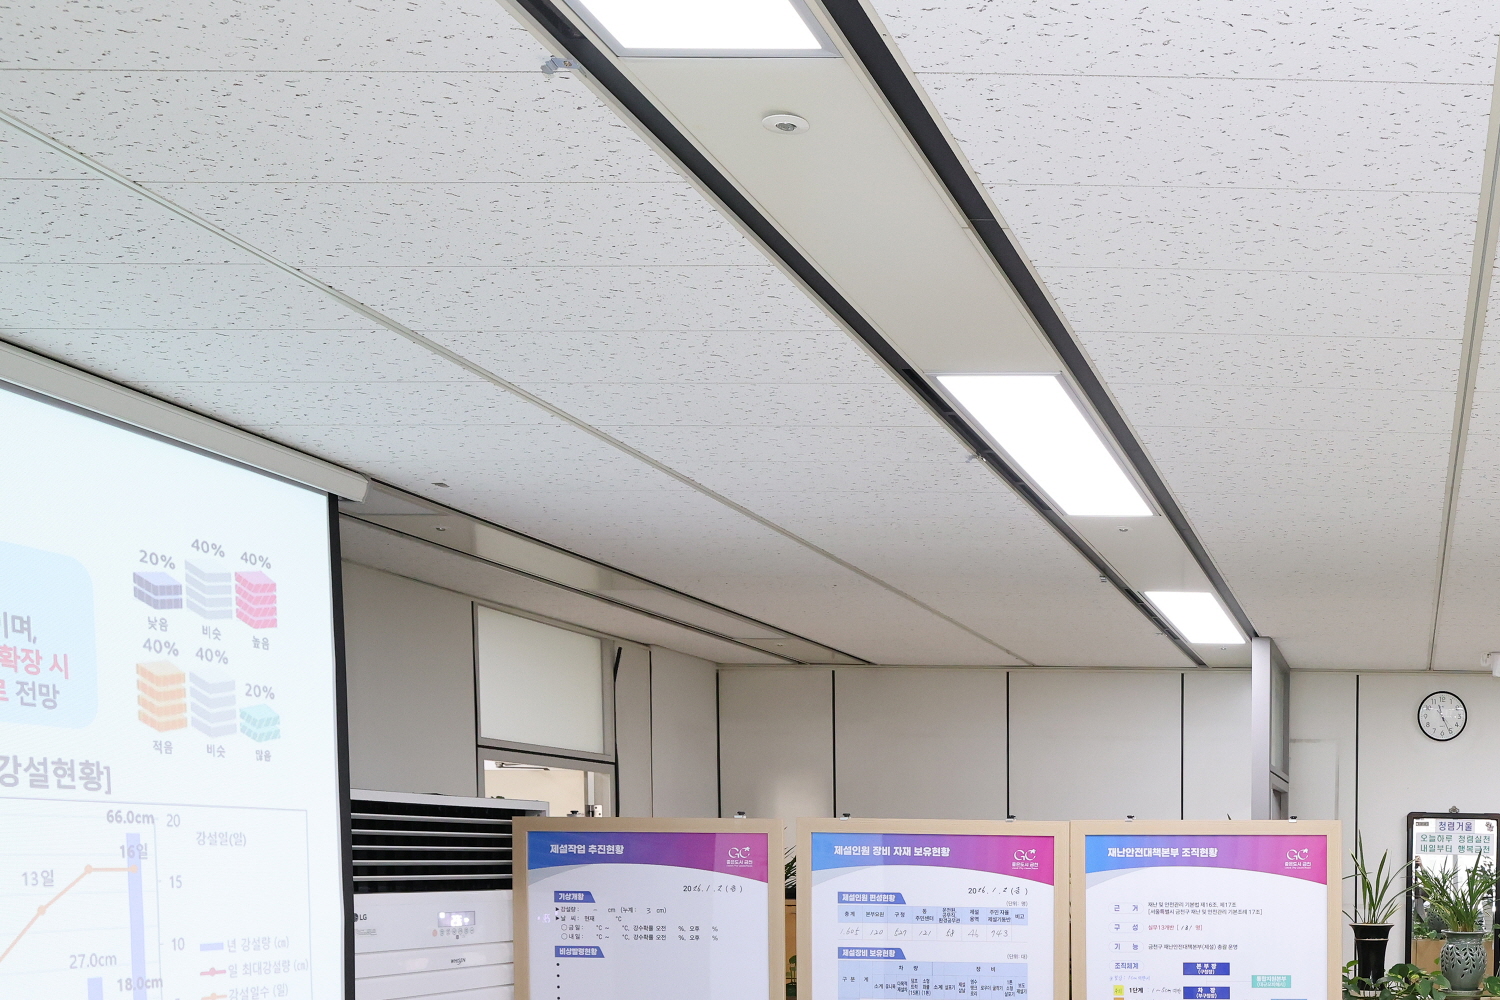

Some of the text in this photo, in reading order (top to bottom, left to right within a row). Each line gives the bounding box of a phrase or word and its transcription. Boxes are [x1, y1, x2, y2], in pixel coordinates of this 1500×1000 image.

[191, 539, 225, 558] 40%
[139, 549, 176, 570] 20%
[240, 552, 272, 570] 40%
[202, 625, 222, 641] 비슷
[143, 638, 179, 656] 40%
[252, 635, 270, 650] 높음
[195, 647, 229, 665] 40%
[49, 653, 69, 680] 시
[15, 680, 60, 710] 전망
[245, 683, 275, 700] 20%
[153, 740, 173, 755] 적음
[206, 744, 226, 759] 비슷
[106, 810, 155, 824] 66.0cm
[166, 814, 180, 827] 20
[1438, 821, 1473, 831] 청렴거울
[196, 831, 246, 847] 강설일(일)
[1420, 834, 1490, 843] 오늘하루 청렴실천
[120, 843, 148, 860] 16일
[550, 844, 624, 855] 제설작업 추진현황
[834, 846, 950, 857] 제설인원 장비 자재 보유현황
[1107, 847, 1218, 858] 재난안전대책본부 조직현황
[1420, 844, 1452, 852] 내일부터
[22, 869, 54, 887] 13일
[170, 875, 182, 889] 15
[842, 893, 868, 902] 제설인원
[360, 913, 367, 921] LG
[172, 937, 185, 951] 10
[227, 937, 271, 953] 년 강설량
[842, 949, 868, 957] 제설장비
[69, 953, 117, 969] 27.0cm
[228, 960, 290, 978] 일 최대강설량
[117, 977, 163, 992] 18.0cm
[273, 983, 288, 997] (일)
